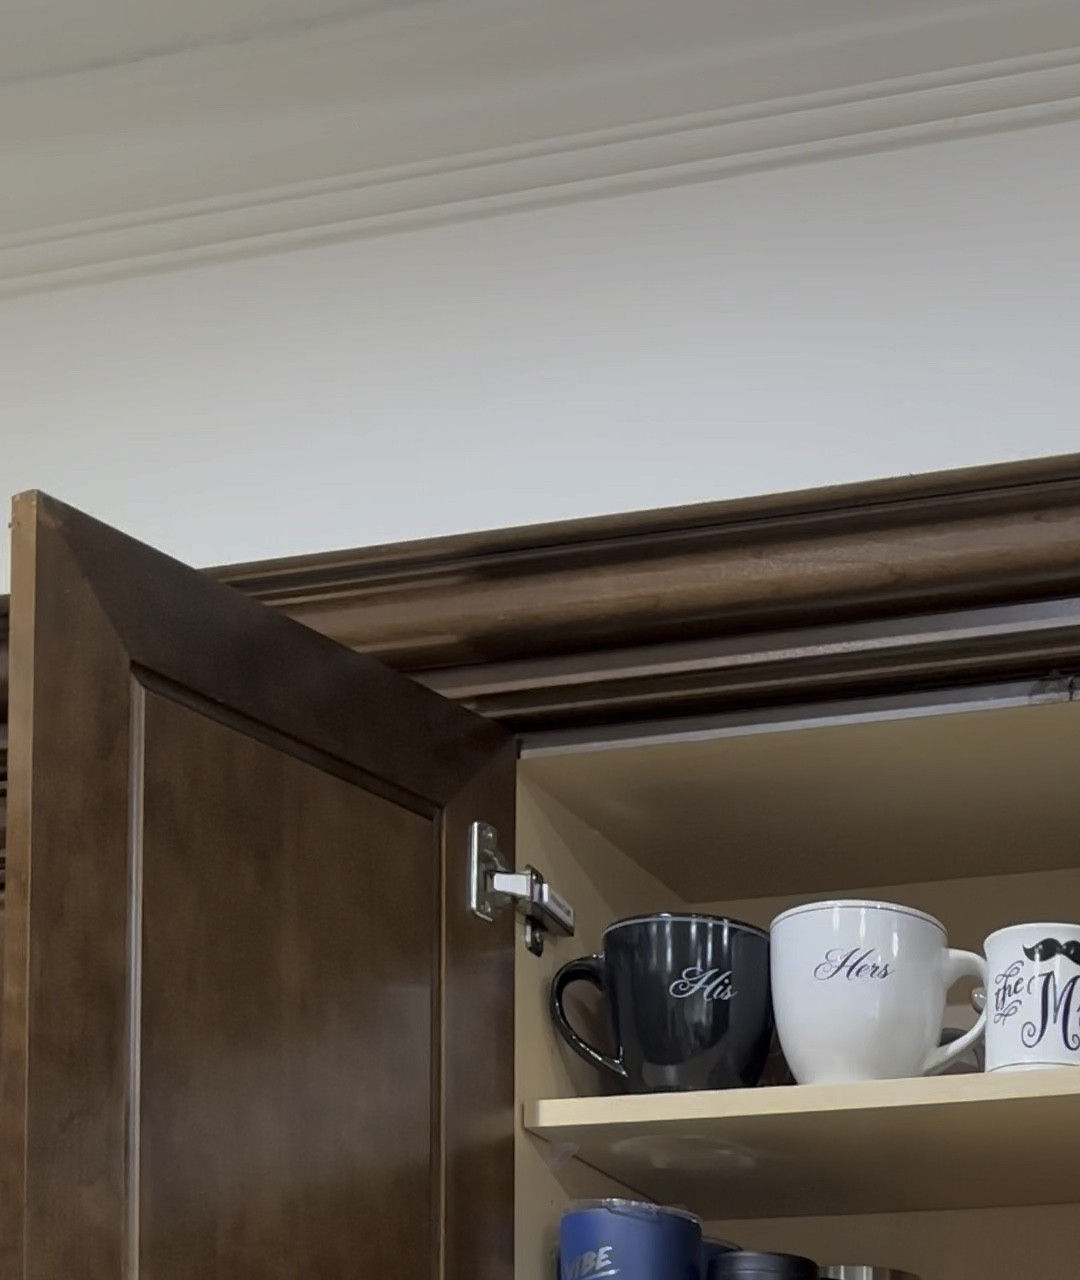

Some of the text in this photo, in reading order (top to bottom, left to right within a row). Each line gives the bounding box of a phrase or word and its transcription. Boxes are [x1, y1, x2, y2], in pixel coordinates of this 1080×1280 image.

[812, 947, 896, 981] Hers
[669, 966, 738, 1002] His
[994, 960, 1025, 1026] the
